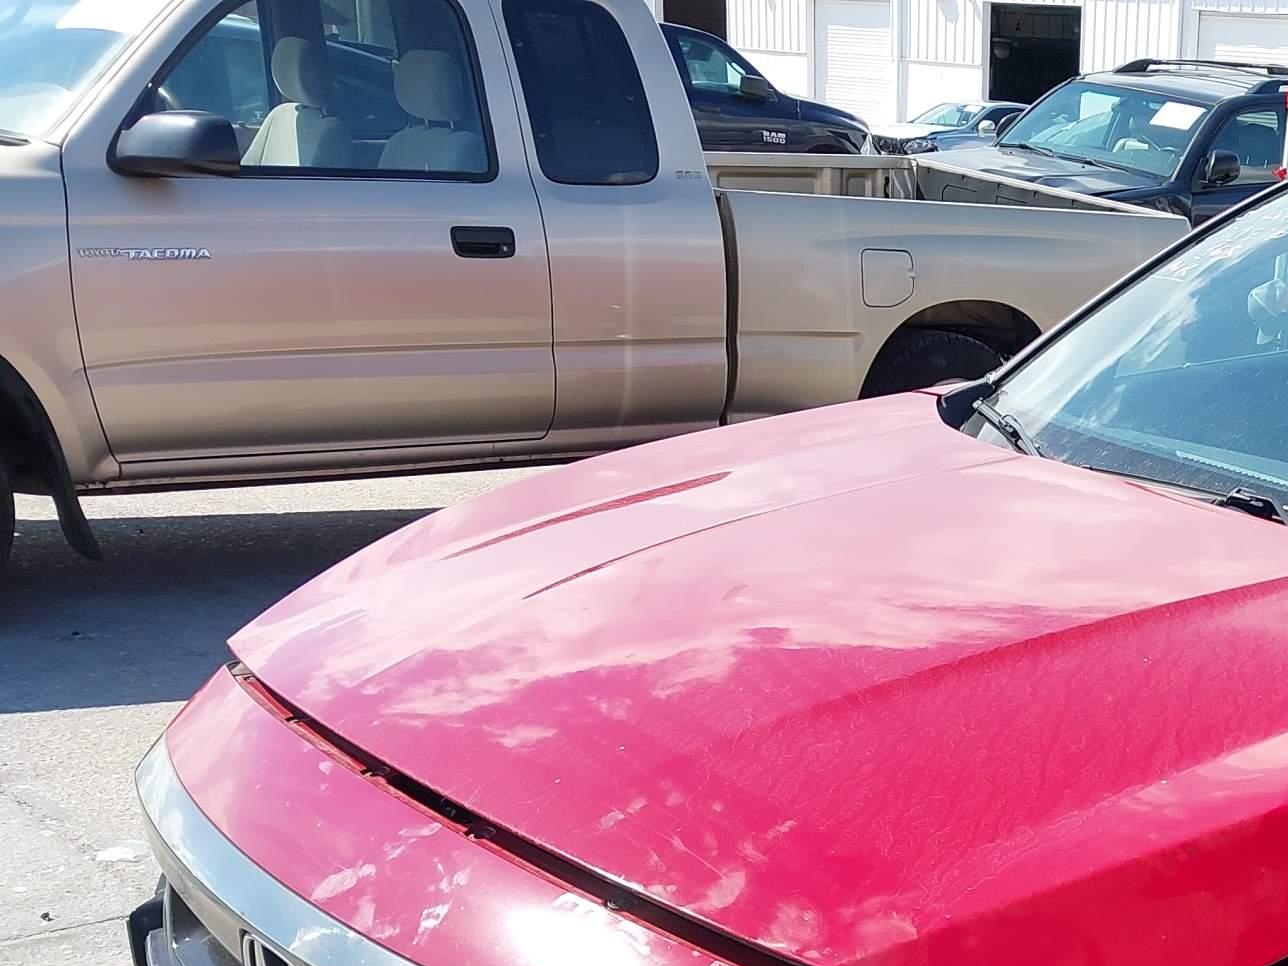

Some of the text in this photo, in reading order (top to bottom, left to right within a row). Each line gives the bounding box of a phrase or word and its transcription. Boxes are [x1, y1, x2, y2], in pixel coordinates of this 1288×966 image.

[763, 130, 786, 138] RAM
[763, 136, 786, 144] 1500
[77, 248, 210, 260] TOYOTA TACOMA
